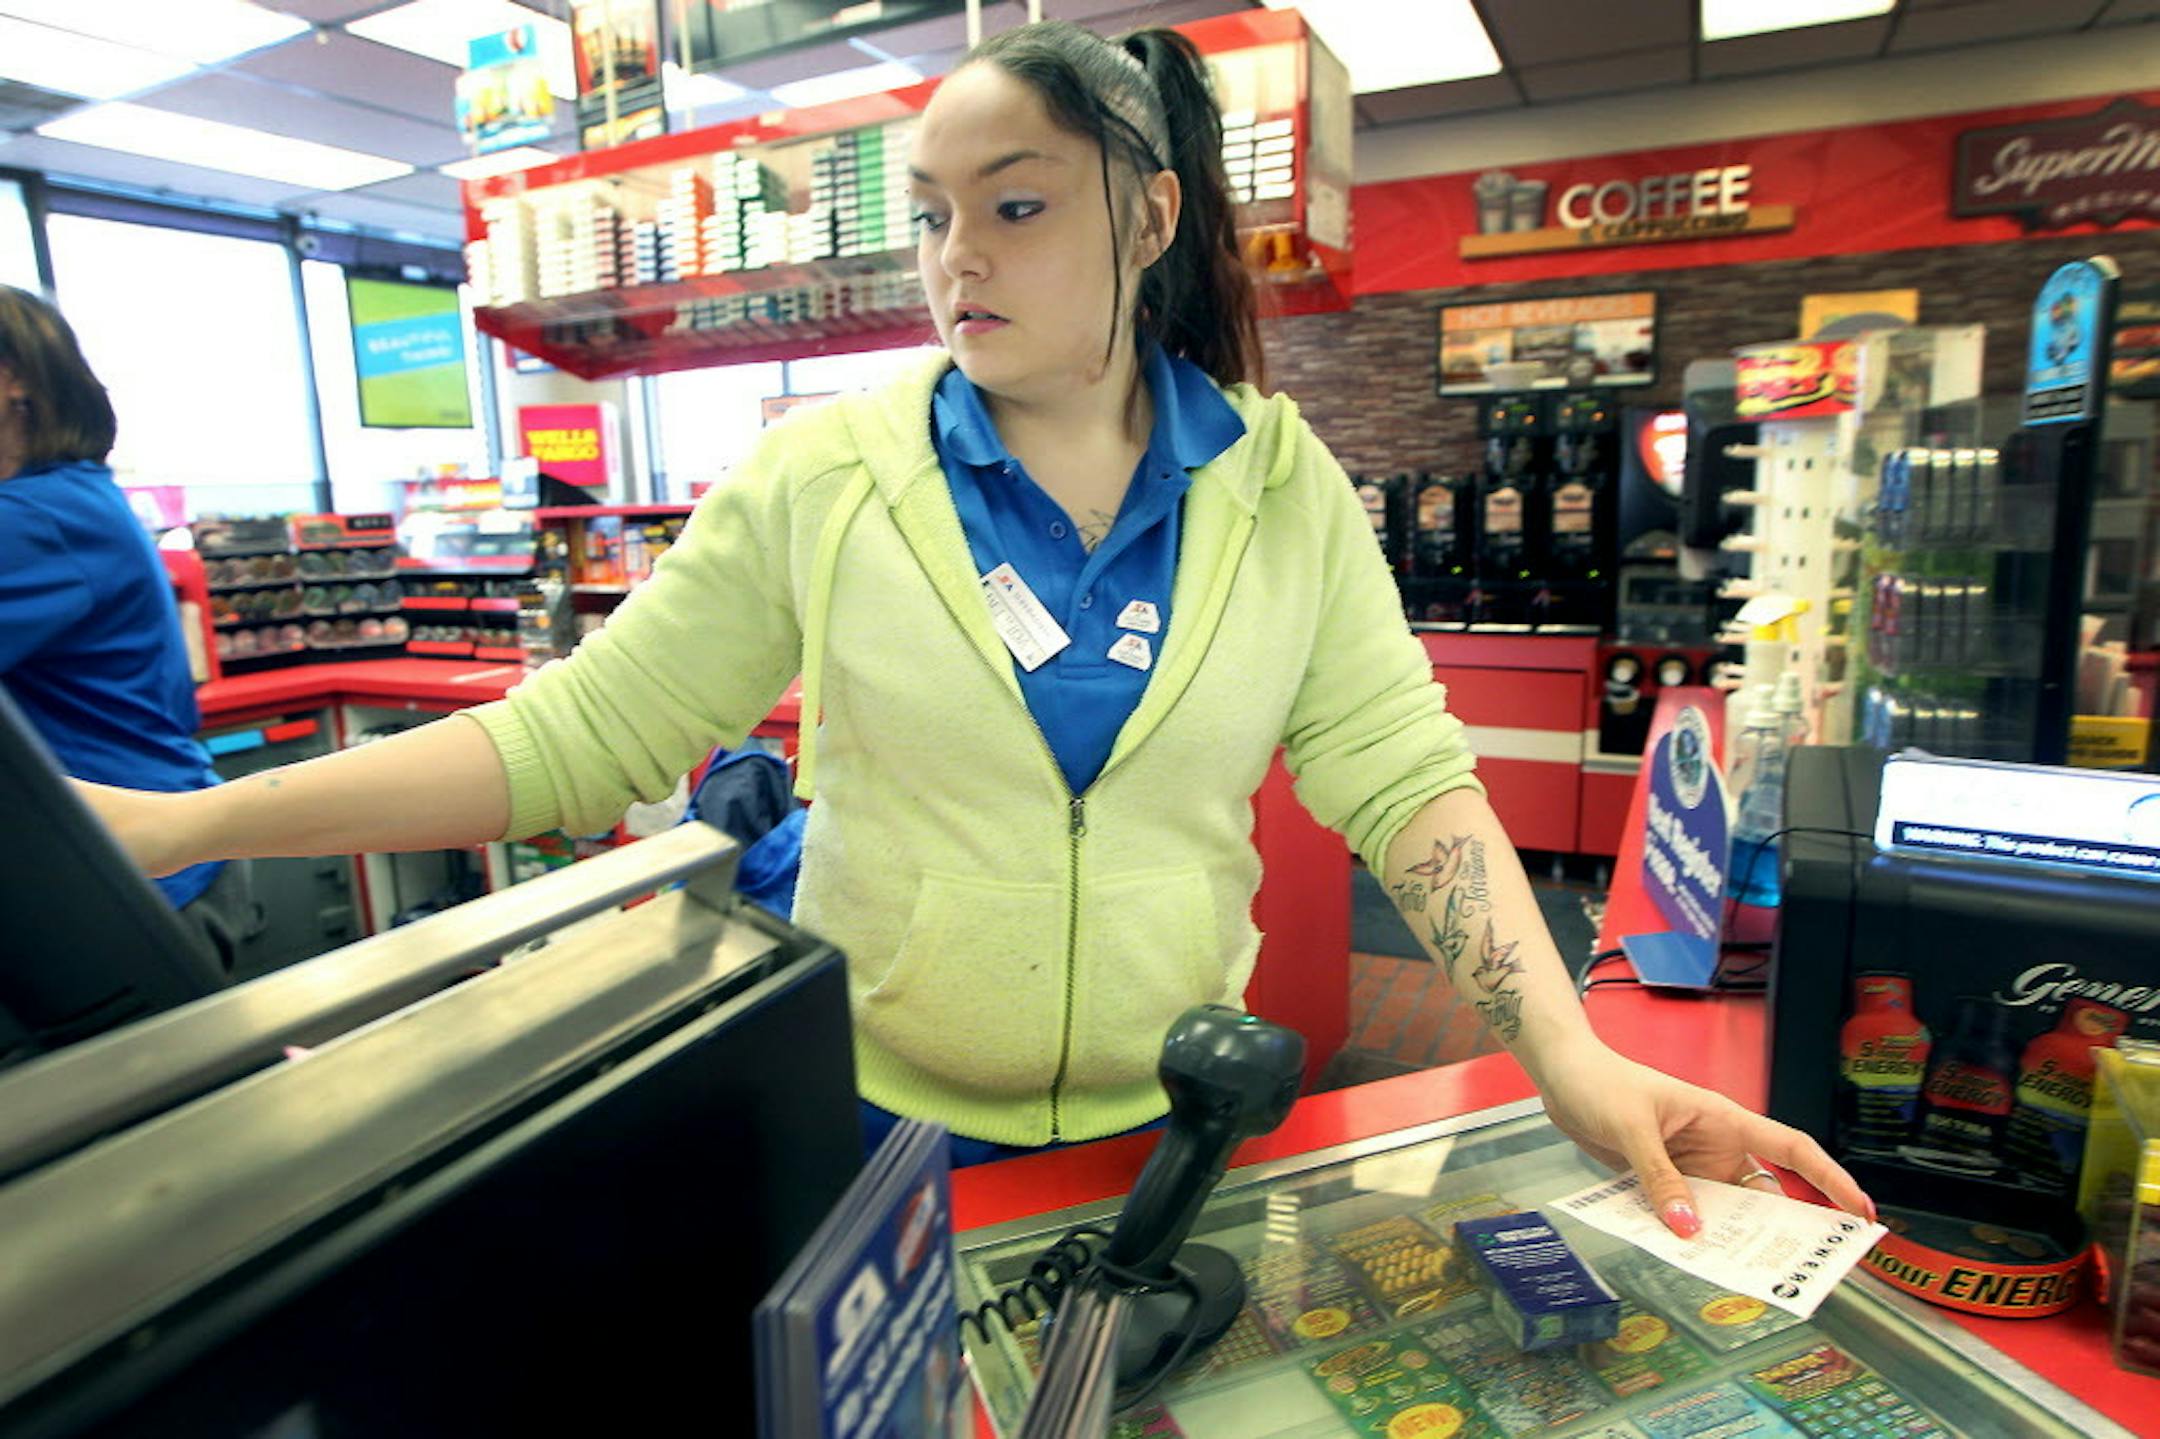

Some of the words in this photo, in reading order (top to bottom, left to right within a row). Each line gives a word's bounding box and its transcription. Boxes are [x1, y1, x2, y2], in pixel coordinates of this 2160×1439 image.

[1557, 164, 1752, 230] COFFEE
[526, 429, 597, 445] WELLS
[530, 444, 598, 461] FARGO
[1852, 1059, 1925, 1076] ENERGY
